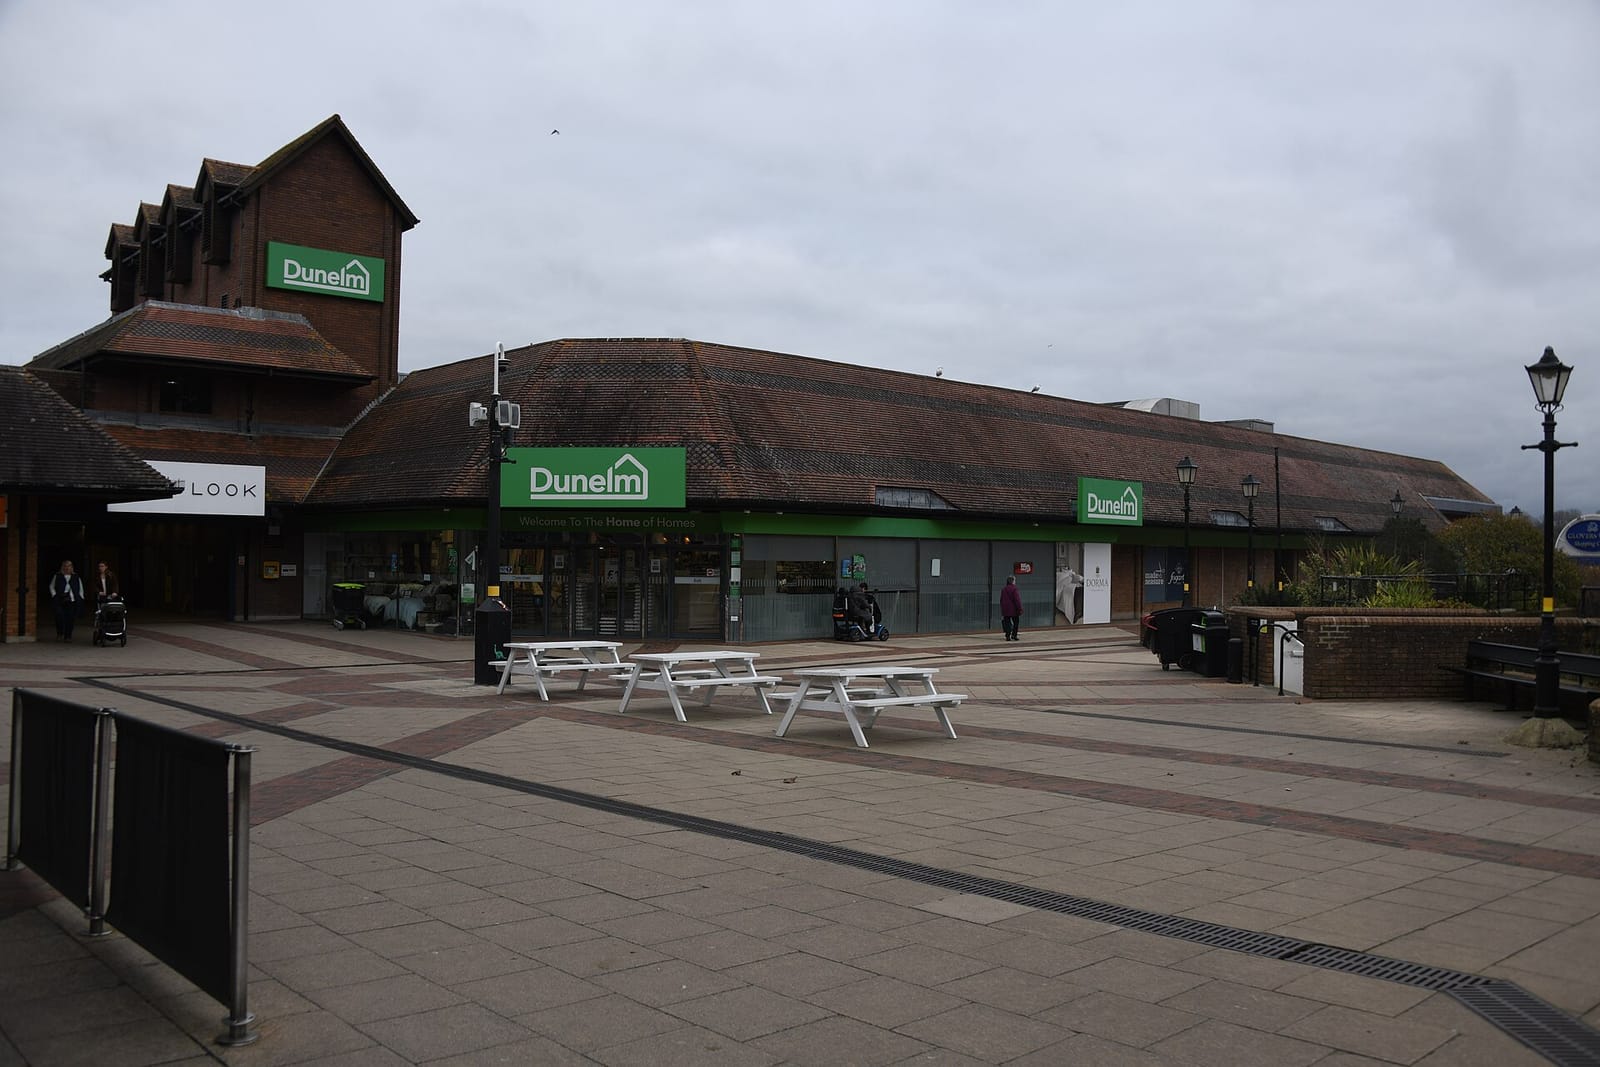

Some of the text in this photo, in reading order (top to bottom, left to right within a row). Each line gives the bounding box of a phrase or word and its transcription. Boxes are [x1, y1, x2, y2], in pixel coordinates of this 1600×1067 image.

[283, 259, 366, 290] Dunelm
[191, 482, 257, 498] LOOK
[530, 465, 642, 494] Dunelm
[1088, 492, 1135, 516] Dunelm
[520, 516, 696, 528] Welcome To The Home of Homes
